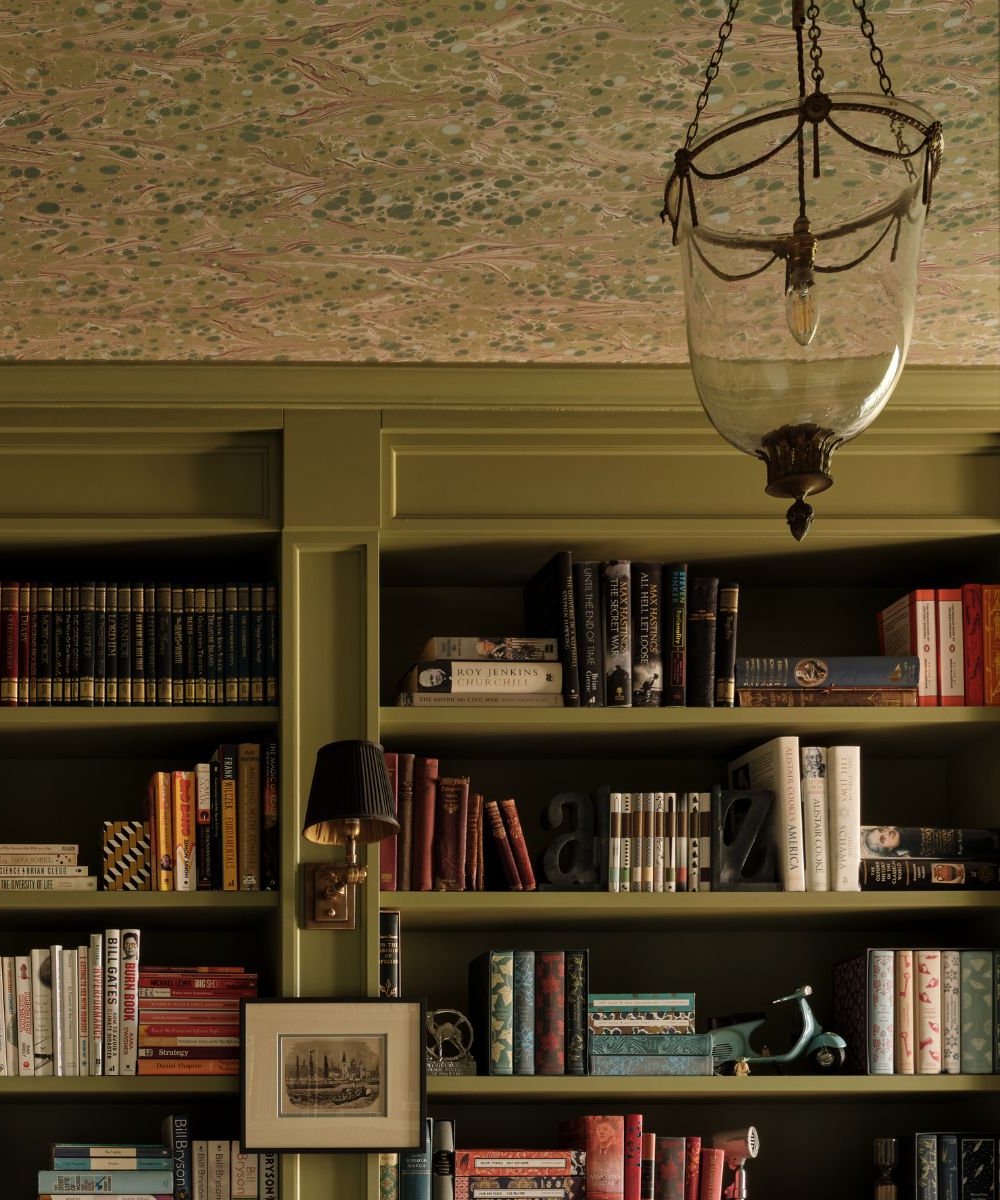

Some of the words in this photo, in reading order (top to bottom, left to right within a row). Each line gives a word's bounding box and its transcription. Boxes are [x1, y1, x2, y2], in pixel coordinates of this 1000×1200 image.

[584, 568, 592, 592] UNTIL
[610, 578, 618, 597] THE
[640, 573, 648, 589] ALL
[585, 594, 593, 608] THE
[640, 592, 648, 614] HELL
[20, 615, 28, 642] DIARY
[107, 615, 117, 639] LORD
[585, 611, 593, 629] END
[674, 610, 682, 644] Rationality
[586, 631, 594, 642] OF
[611, 636, 619, 656] WAR
[587, 644, 595, 665] TIME
[487, 669, 538, 677] JENKINS
[591, 673, 599, 690] Brian
[224, 757, 233, 778] FRANK
[225, 782, 233, 809] WILCZEK
[813, 799, 821, 837] ALISTAIR
[225, 817, 235, 869] FUNDAMENTALS
[788, 824, 798, 870] AMERICA
[815, 839, 823, 873] COOKE
[26, 867, 45, 875] BRIAN
[47, 867, 67, 875] CLEGG
[1, 880, 10, 889] THE
[10, 880, 35, 889] DIVERSITY
[36, 880, 42, 889] OF
[43, 880, 53, 889] LIFE
[108, 938, 117, 963] BILL
[107, 967, 117, 1005] GATES
[124, 963, 135, 990] BURN
[124, 994, 135, 1021] BOOK
[175, 1119, 187, 1137] Bill
[174, 1140, 187, 1186] Bryson
